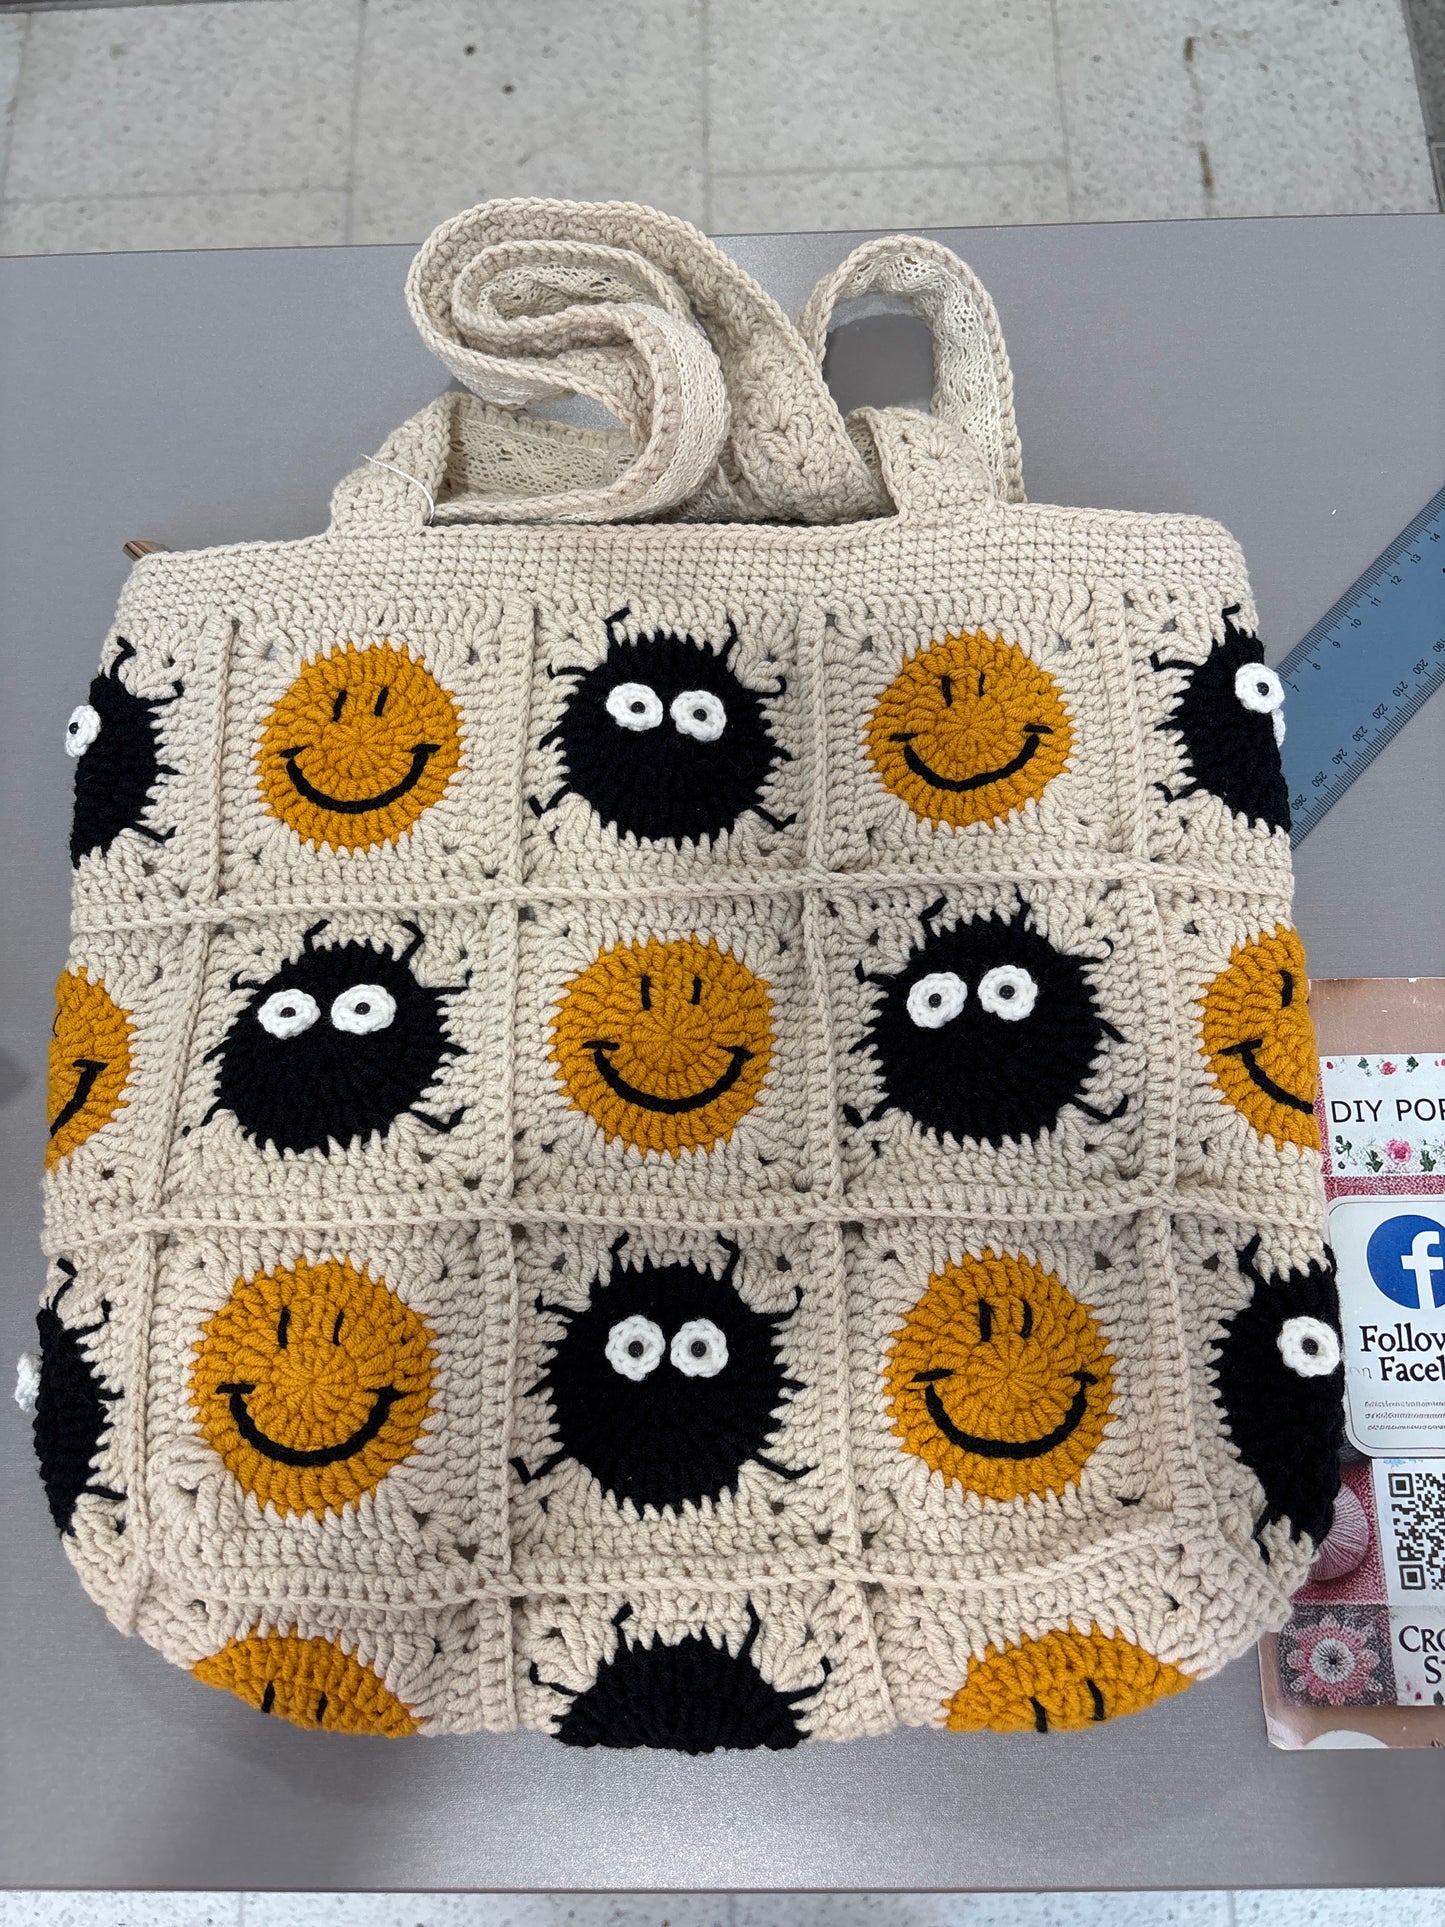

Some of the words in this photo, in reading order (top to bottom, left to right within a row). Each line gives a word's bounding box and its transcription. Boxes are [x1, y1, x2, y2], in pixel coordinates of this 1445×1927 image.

[1291, 684, 1300, 693] 7
[1312, 662, 1321, 671] 8
[1332, 641, 1341, 649] 9
[1350, 618, 1362, 629] 10
[1370, 597, 1382, 607] 11
[1390, 575, 1402, 586] 12
[1410, 553, 1422, 564] 13
[1429, 532, 1441, 543] 14
[1412, 658, 1429, 675] 200
[1392, 680, 1409, 697] 210
[1372, 703, 1388, 720] 220
[1351, 725, 1368, 742] 230
[1331, 748, 1348, 765] 240
[1311, 771, 1328, 788] 250
[1290, 794, 1307, 811] 260
[1330, 1099, 1383, 1123] DIY
